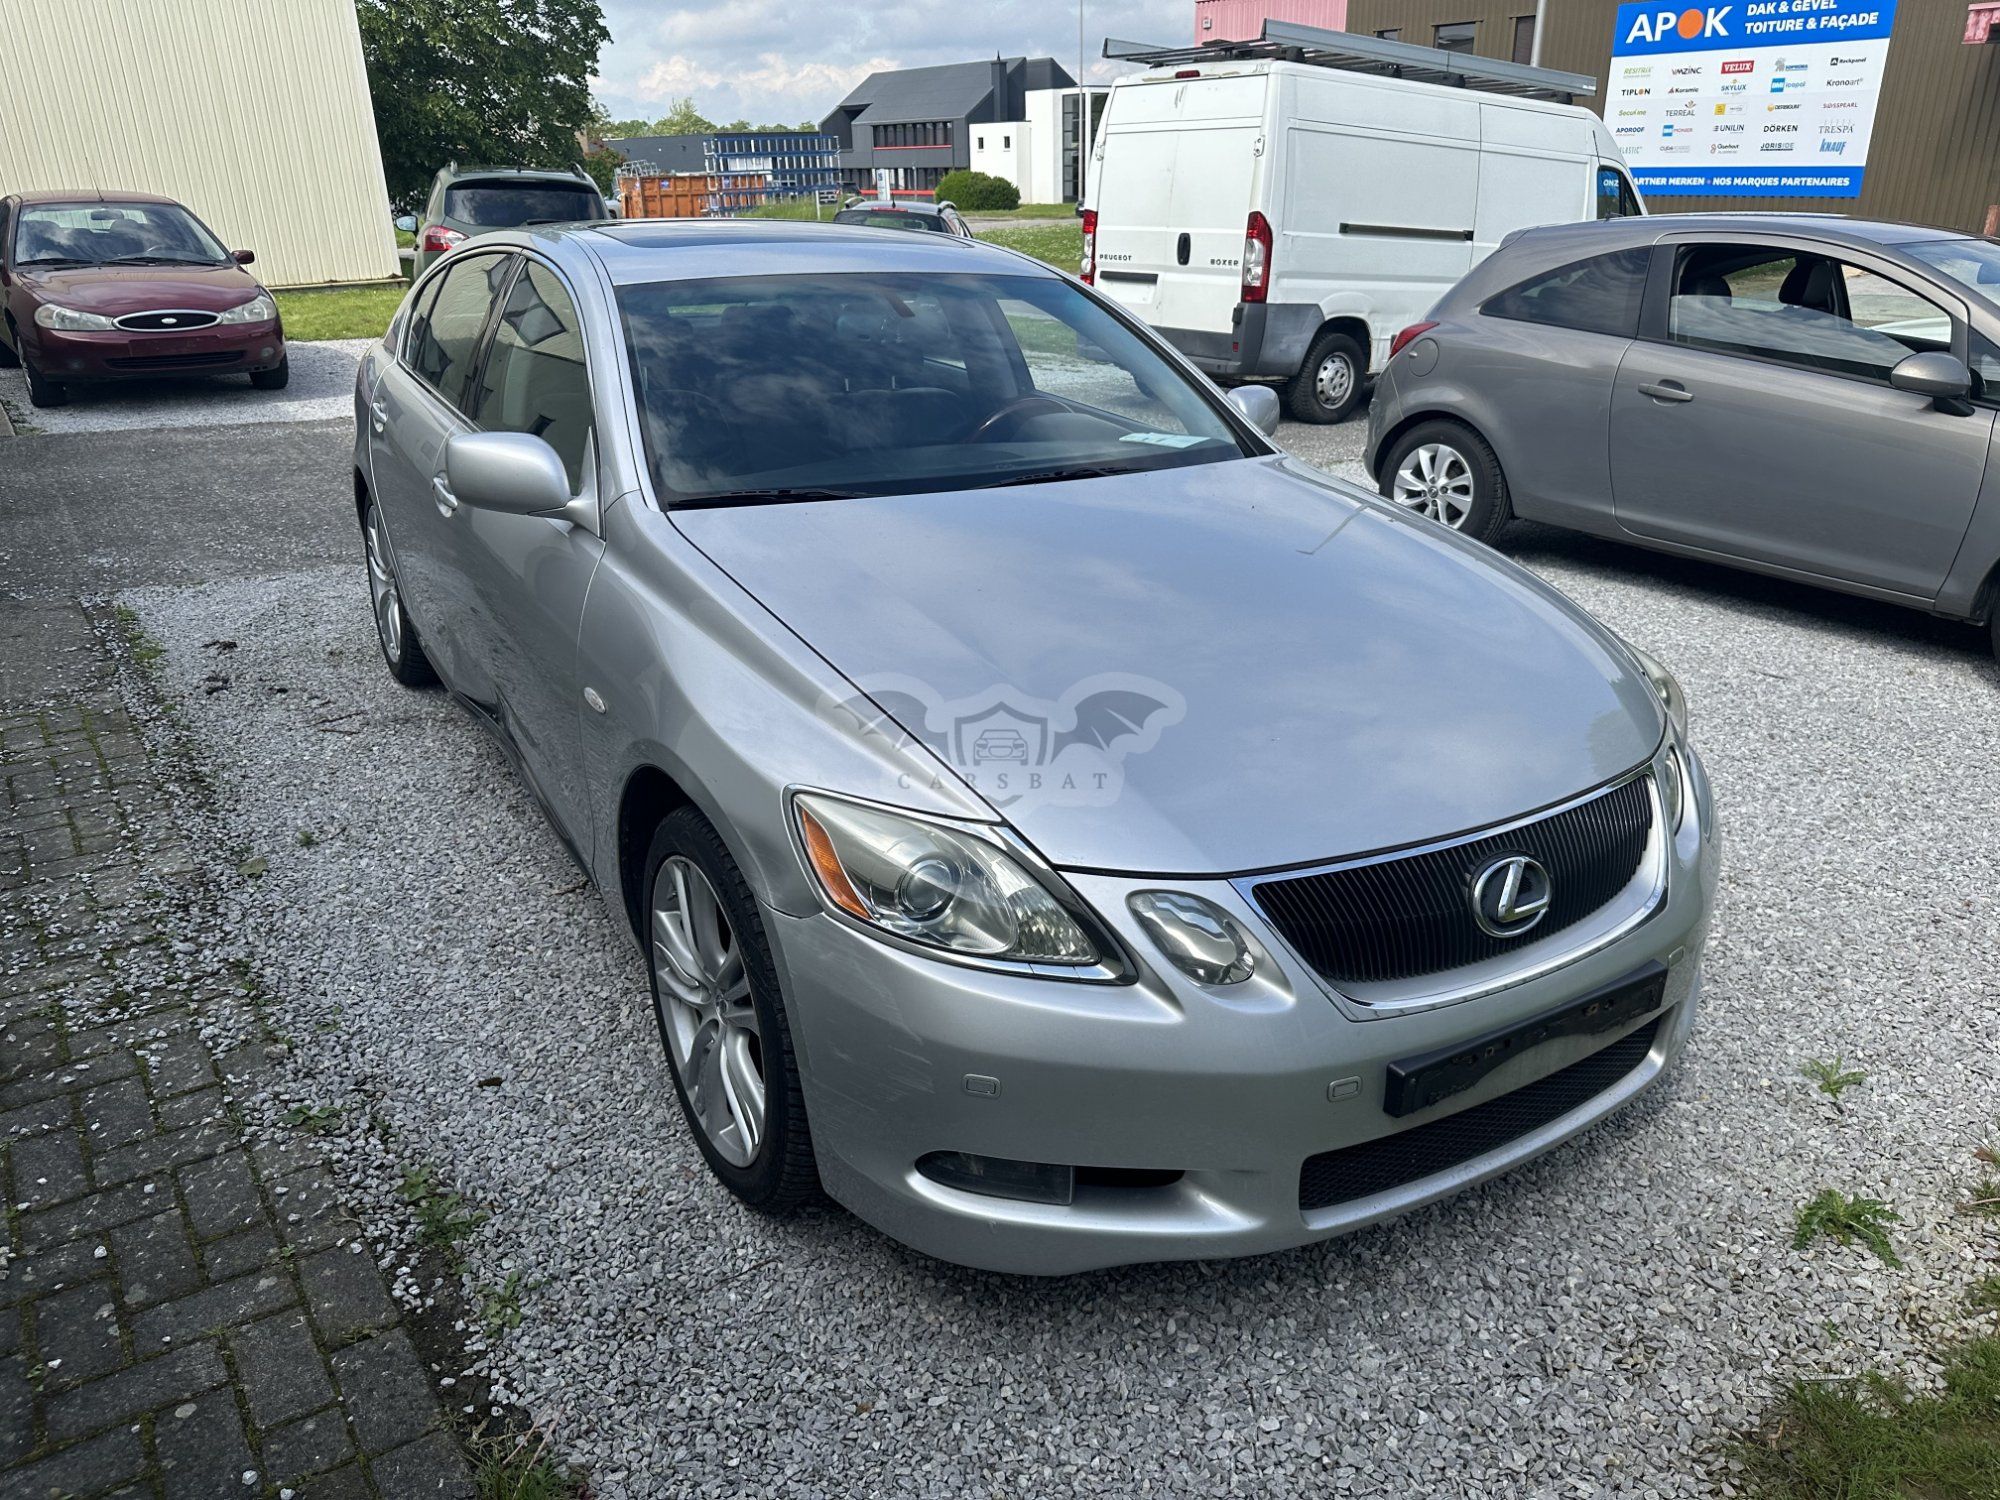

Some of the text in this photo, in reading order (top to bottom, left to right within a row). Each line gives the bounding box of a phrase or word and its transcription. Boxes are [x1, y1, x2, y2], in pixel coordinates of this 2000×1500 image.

[1747, 0, 1837, 16] DAK & GEVEL
[1625, 6, 1733, 44] APOK
[1745, 12, 1879, 34] TOITURE & FAÇADE
[1724, 61, 1752, 72] VELUX
[1621, 88, 1651, 96] TIPLON
[1665, 109, 1695, 117] TERREAL
[1719, 124, 1744, 132] UNILIN
[1764, 124, 1798, 132] DÖRKEN
[1818, 125, 1853, 134] TRESPA
[1634, 177, 1667, 186] ARTNER
[1668, 177, 1705, 186] MERKEN
[1712, 177, 1732, 186] NOS
[1733, 177, 1779, 188] MARQUES
[1781, 177, 1850, 187] PARTENAIRES
[1210, 258, 1239, 266] BOXER
